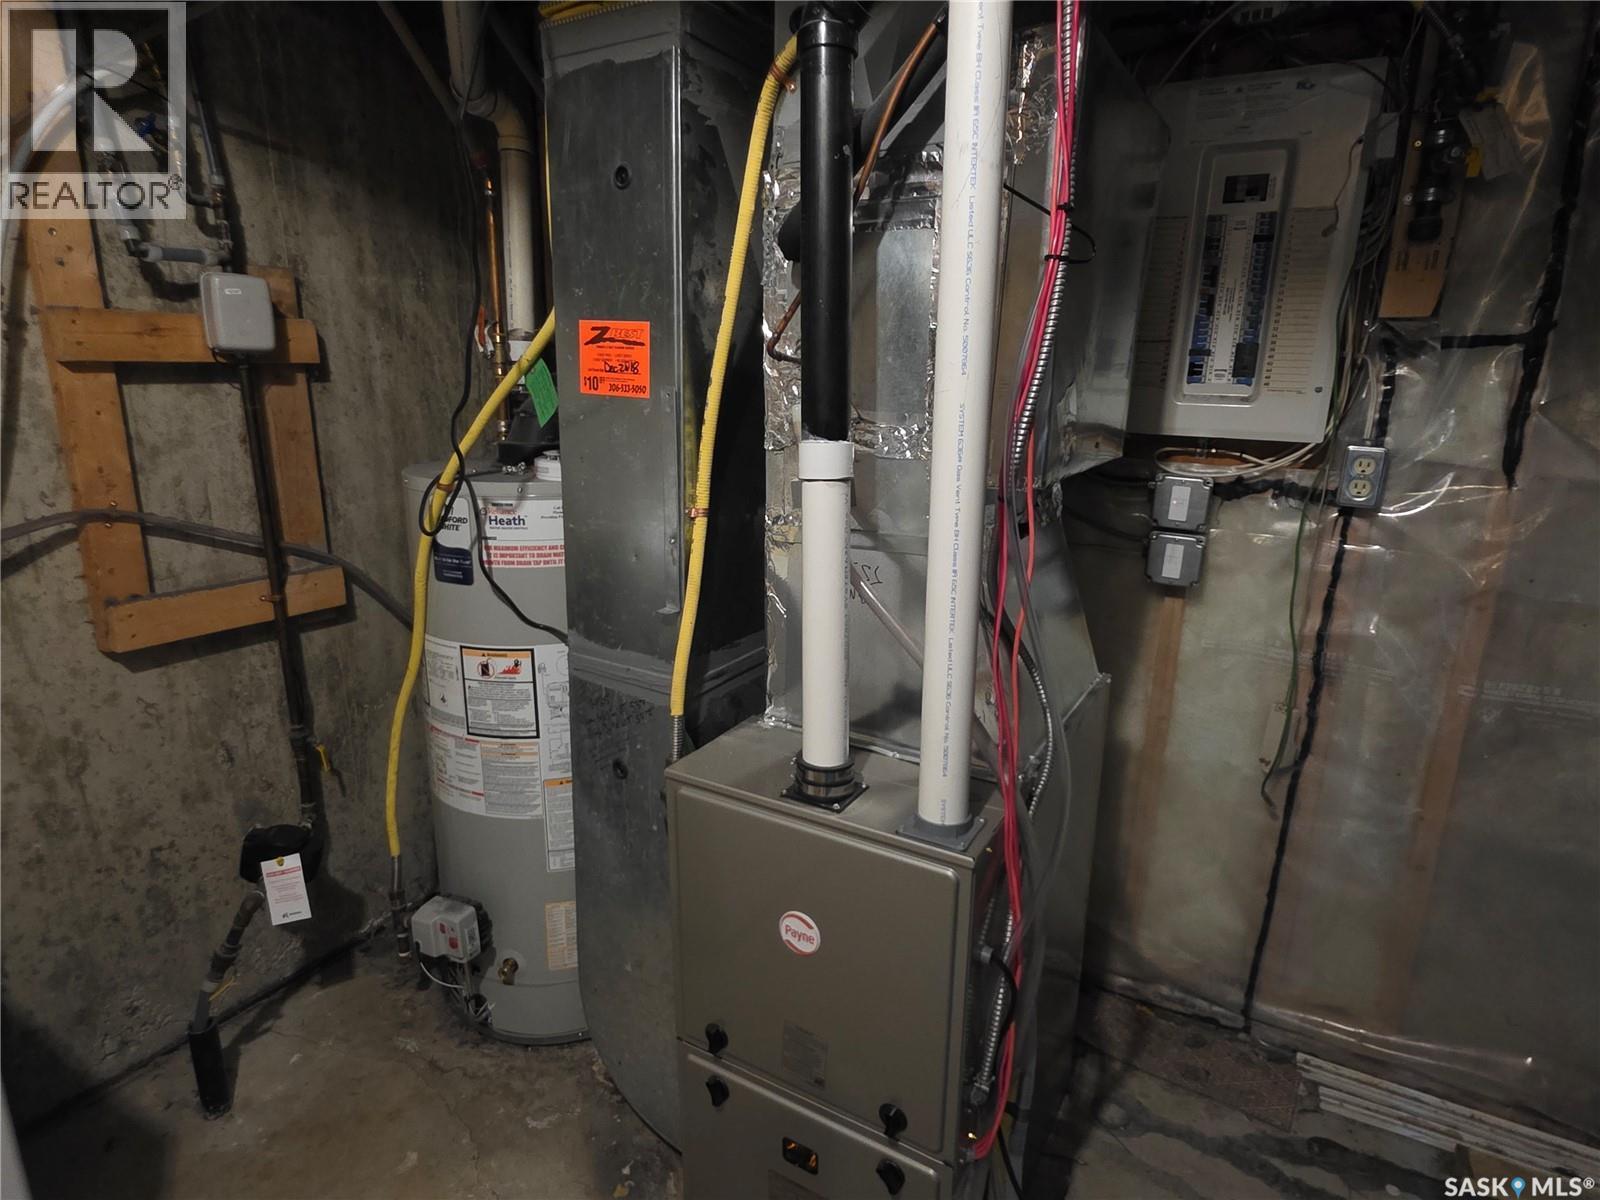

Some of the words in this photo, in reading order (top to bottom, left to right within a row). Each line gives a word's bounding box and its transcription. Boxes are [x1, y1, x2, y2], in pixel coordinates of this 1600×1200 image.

[957, 402, 965, 436] SYSTEM
[489, 515, 526, 526] Heath
[784, 924, 815, 944] Payne
